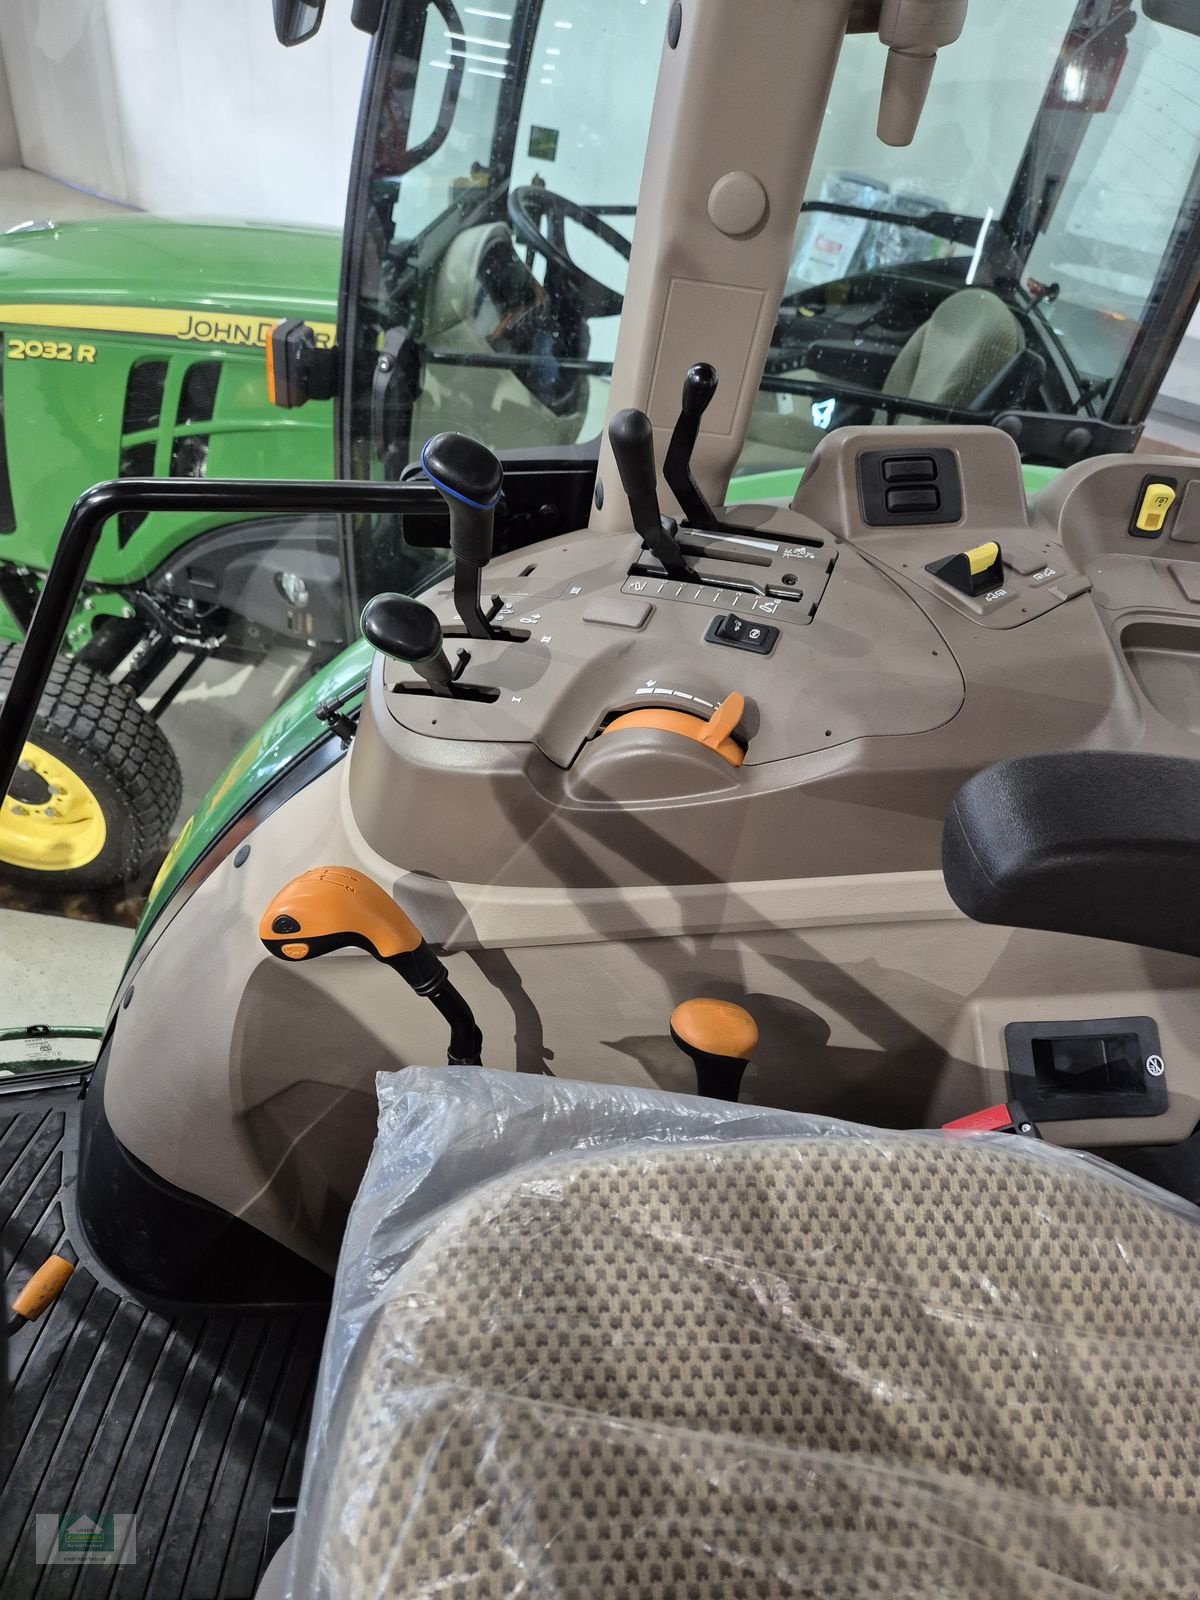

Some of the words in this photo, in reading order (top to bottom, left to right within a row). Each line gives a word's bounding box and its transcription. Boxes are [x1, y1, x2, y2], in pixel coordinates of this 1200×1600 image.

[178, 316, 252, 343] JOHN
[7, 339, 73, 361] 2032
[77, 344, 97, 363] R
